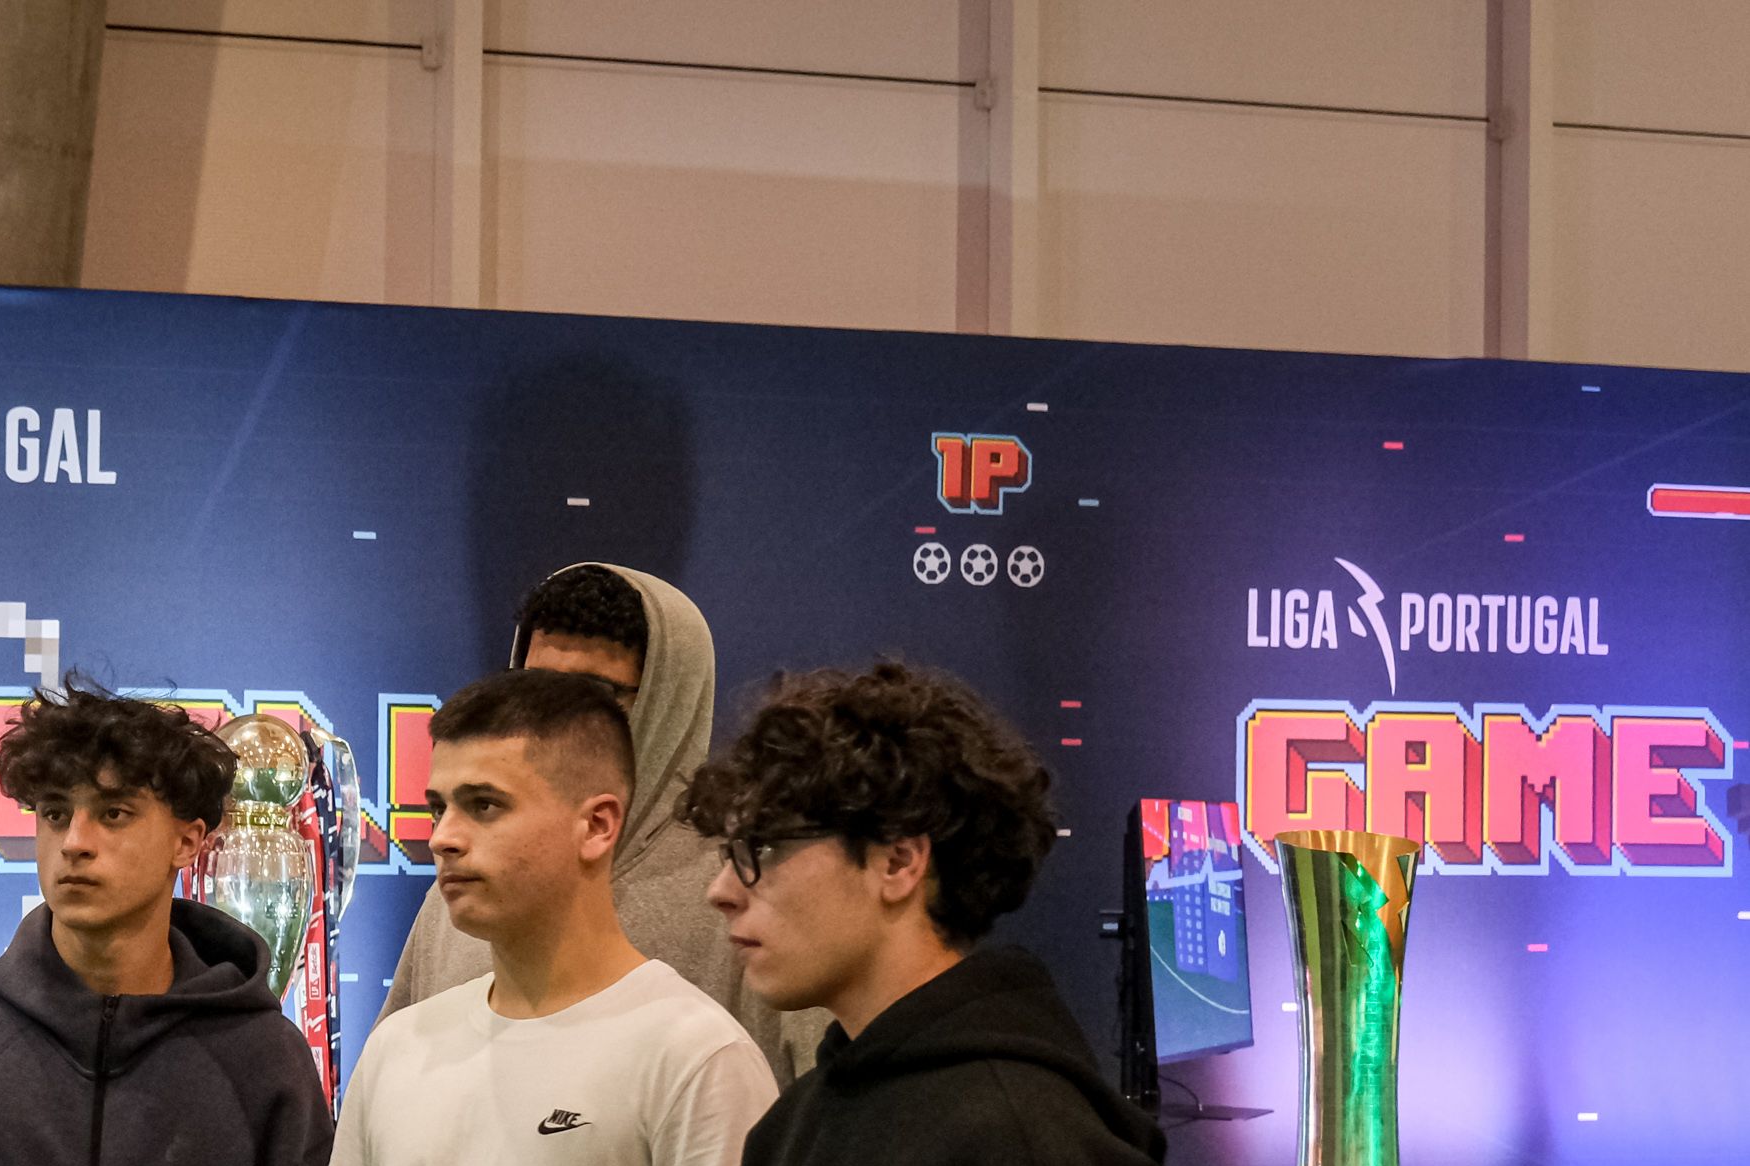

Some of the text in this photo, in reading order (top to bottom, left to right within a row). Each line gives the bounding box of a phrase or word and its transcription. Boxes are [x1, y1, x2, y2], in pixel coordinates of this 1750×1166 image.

[934, 434, 1031, 513] 1P
[1247, 587, 1609, 656] LIGA PORTUGAL
[1241, 703, 1732, 873] GAME
[547, 1109, 581, 1126] NIKE
